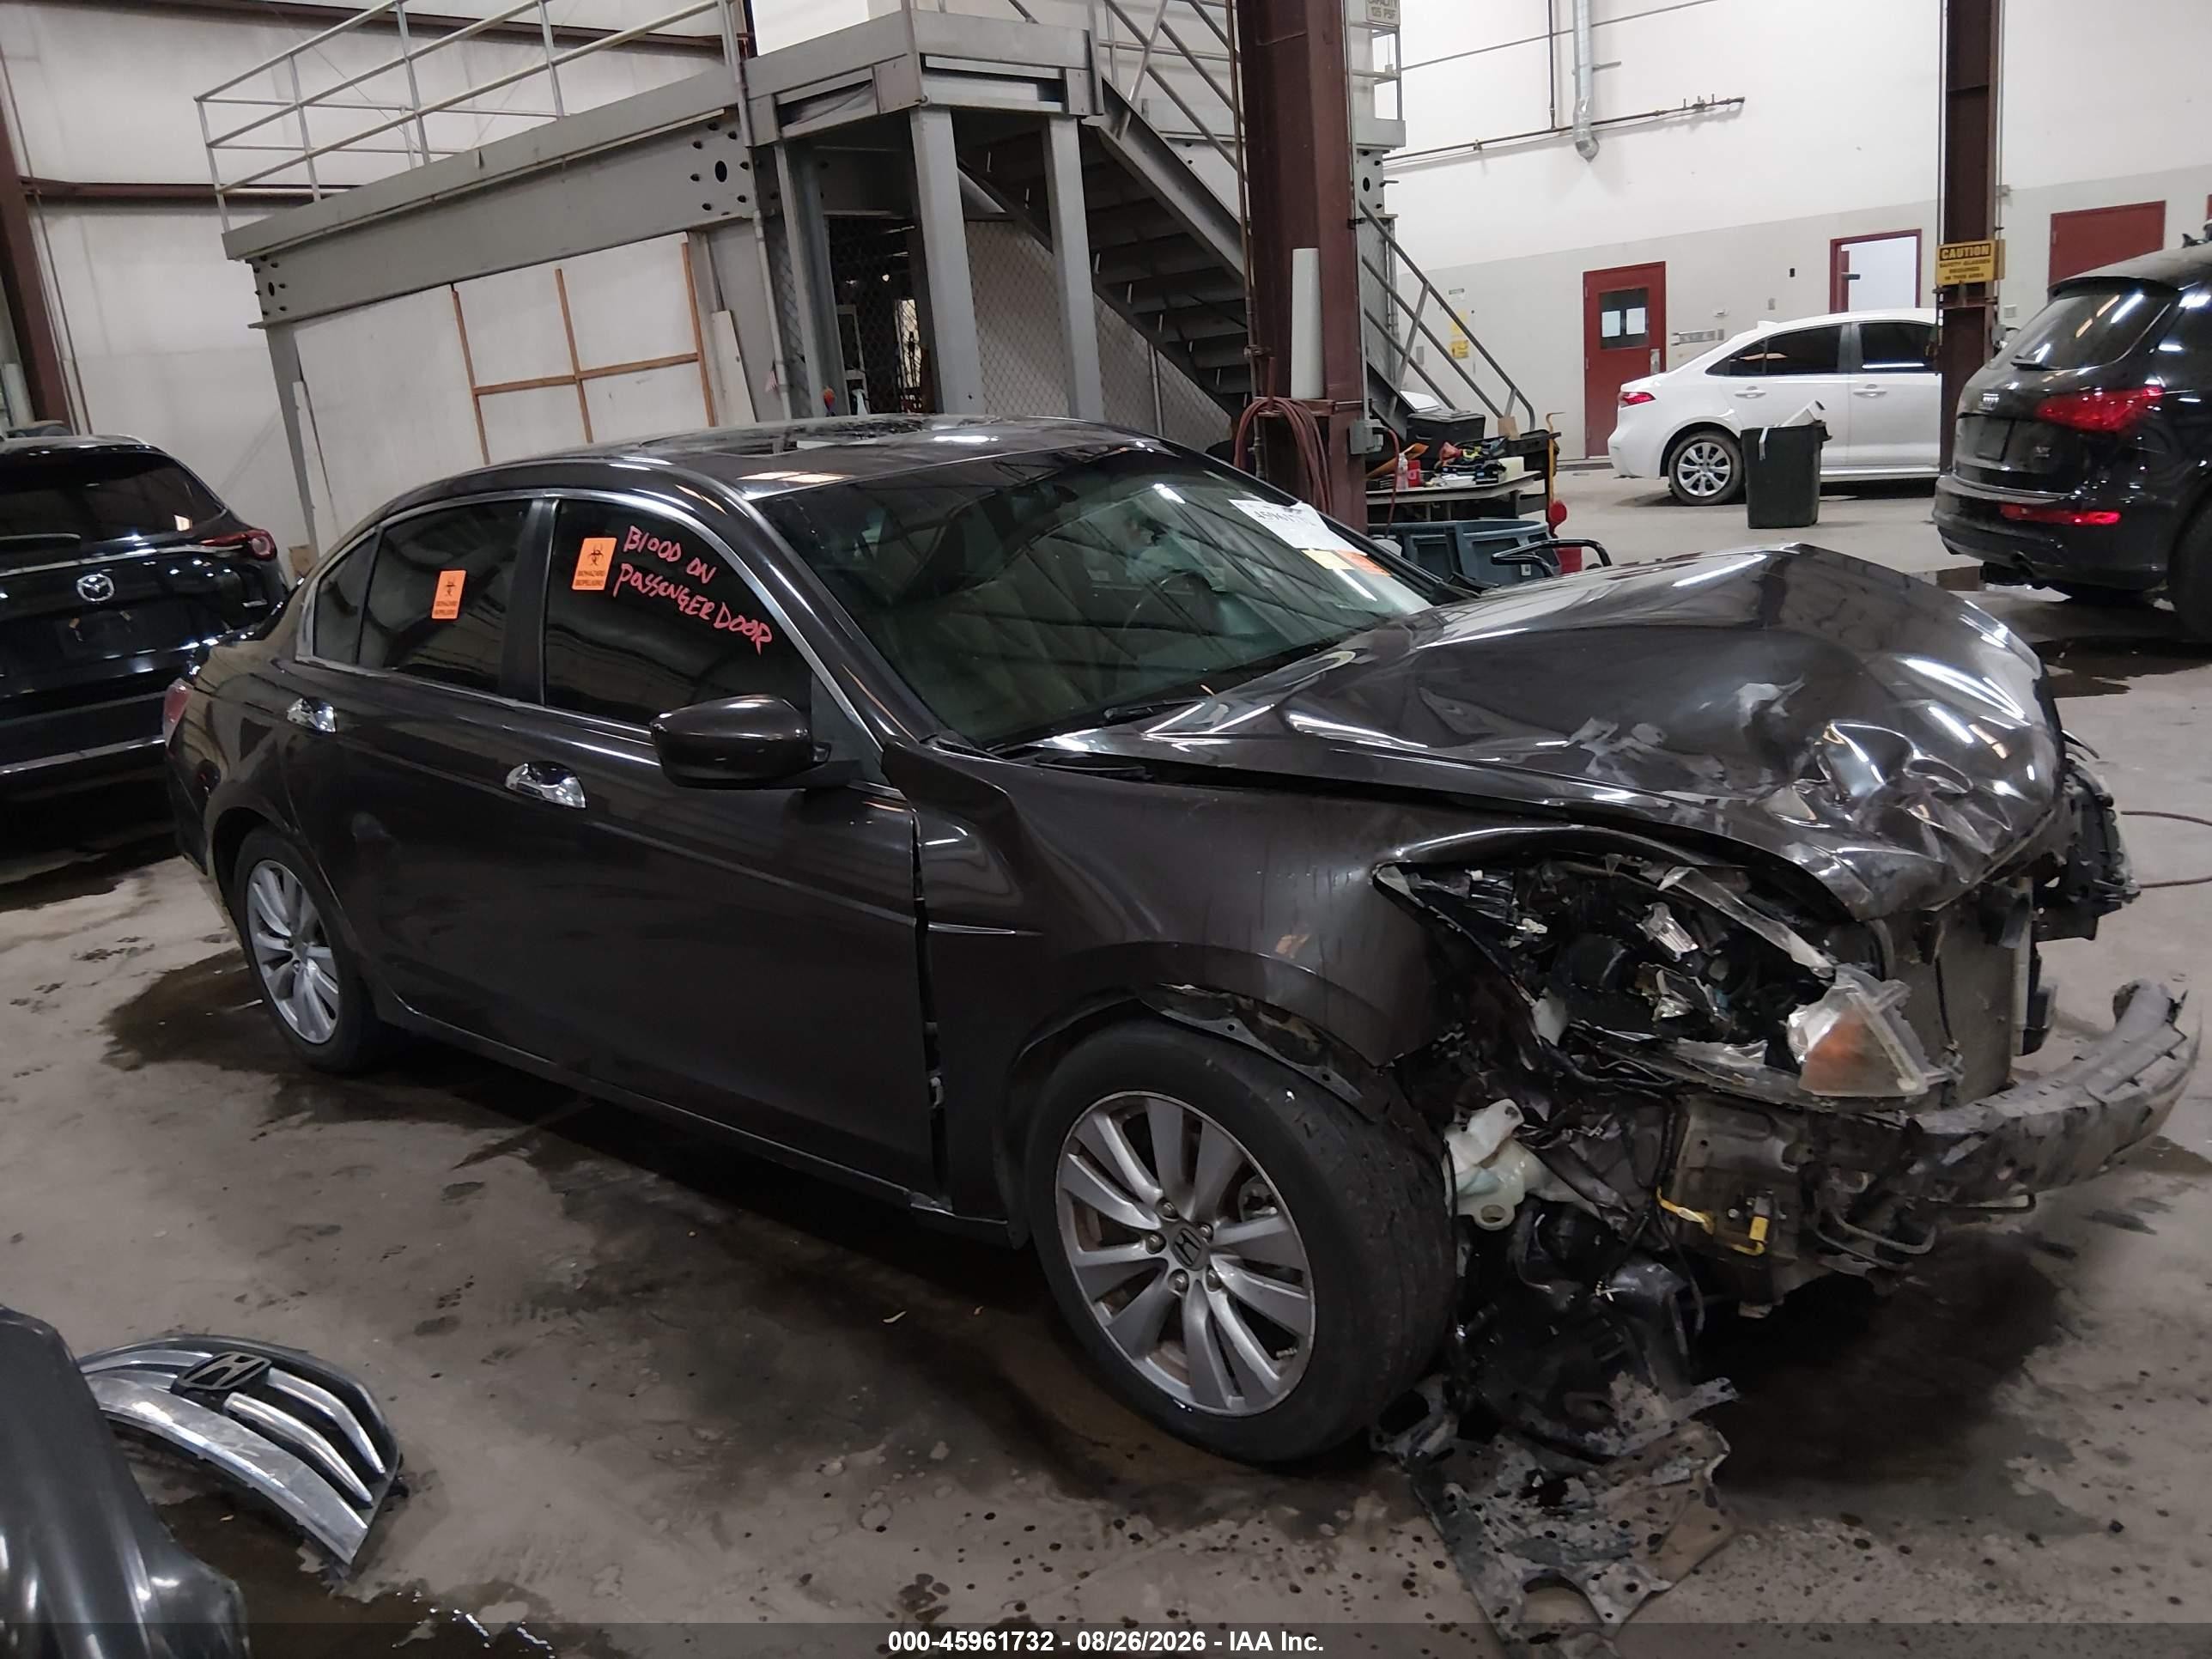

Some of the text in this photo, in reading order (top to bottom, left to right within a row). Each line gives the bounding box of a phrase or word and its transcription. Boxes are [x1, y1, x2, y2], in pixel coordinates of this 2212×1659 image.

[1942, 244, 1990, 259] CAUTION
[686, 556, 717, 584] ON
[713, 601, 773, 656] DOOR
